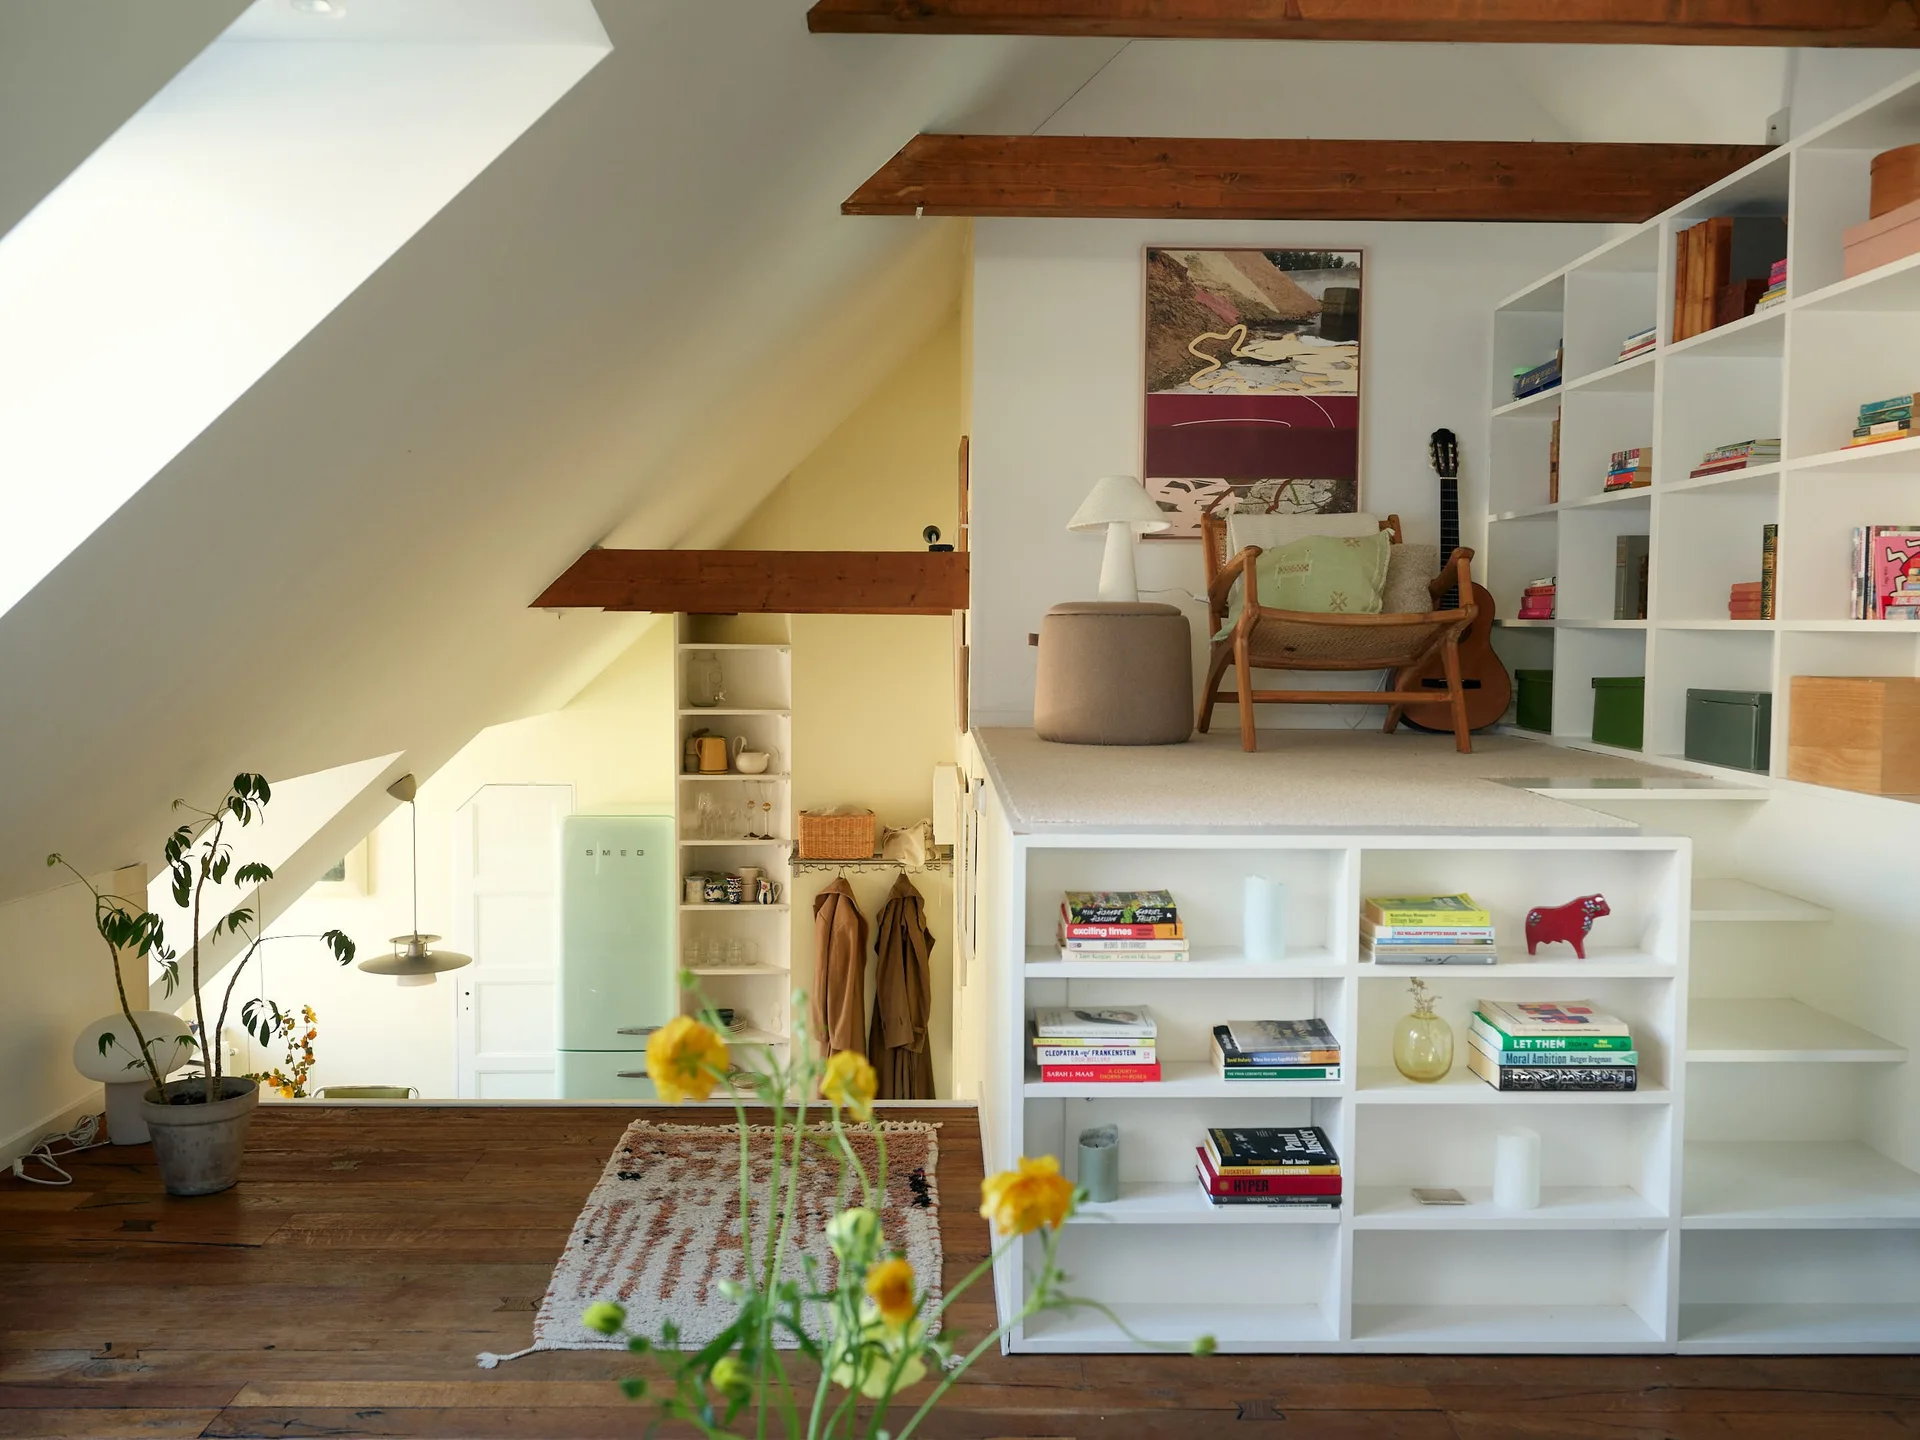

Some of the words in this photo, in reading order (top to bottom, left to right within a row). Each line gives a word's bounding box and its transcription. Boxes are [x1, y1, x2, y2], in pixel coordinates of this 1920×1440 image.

[585, 849, 645, 857] SMEG
[1073, 927, 1107, 937] exciting
[1108, 927, 1132, 936] times
[1513, 1040, 1533, 1049] LET
[1535, 1040, 1566, 1049] THEM
[1506, 1053, 1530, 1064] Moral
[1532, 1053, 1567, 1064] Ambition
[1569, 1056, 1587, 1064] Rutger
[1588, 1056, 1612, 1064] Bregman
[1277, 1133, 1305, 1151] Paul
[1298, 1129, 1327, 1155] Auster
[1233, 1180, 1269, 1192] HYPER
